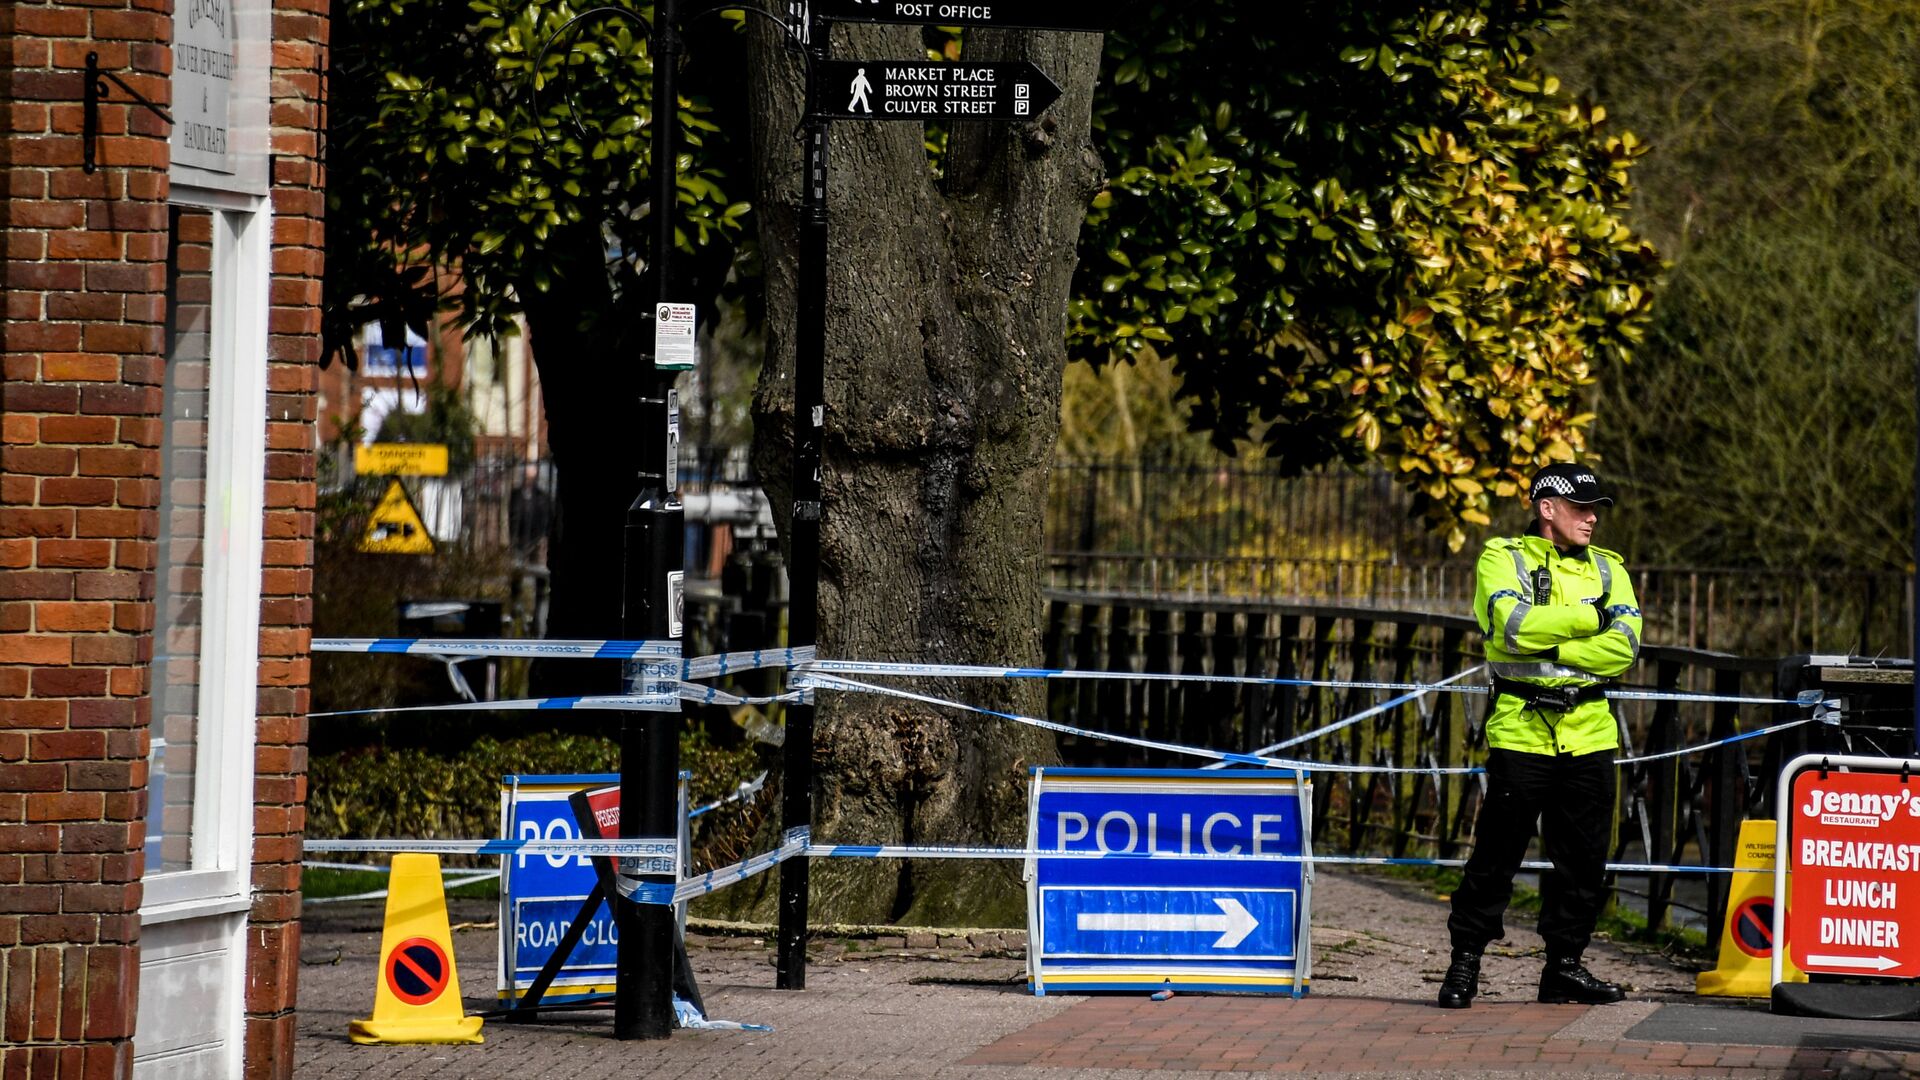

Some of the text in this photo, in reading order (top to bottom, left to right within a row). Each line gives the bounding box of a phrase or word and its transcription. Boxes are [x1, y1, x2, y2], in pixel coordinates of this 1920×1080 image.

[895, 3, 992, 19] POST OFFICE
[177, 43, 198, 73] SILVER
[885, 68, 995, 82] MARKET PLACE
[885, 84, 997, 98] BROWN STREET
[884, 101, 997, 114] CULVER STREET
[184, 121, 226, 155] HANDICRAFTS
[629, 662, 678, 677] CROSS
[1802, 788, 1920, 822] Jenny's
[1823, 815, 1878, 826] RESTAURANT
[1056, 809, 1283, 857] POLICE
[590, 844, 610, 853] DO
[614, 844, 641, 854] NOT
[1801, 838, 1920, 872] BREAKFAST
[1825, 878, 1897, 910] LUNCH
[1820, 917, 1900, 948] DINNER
